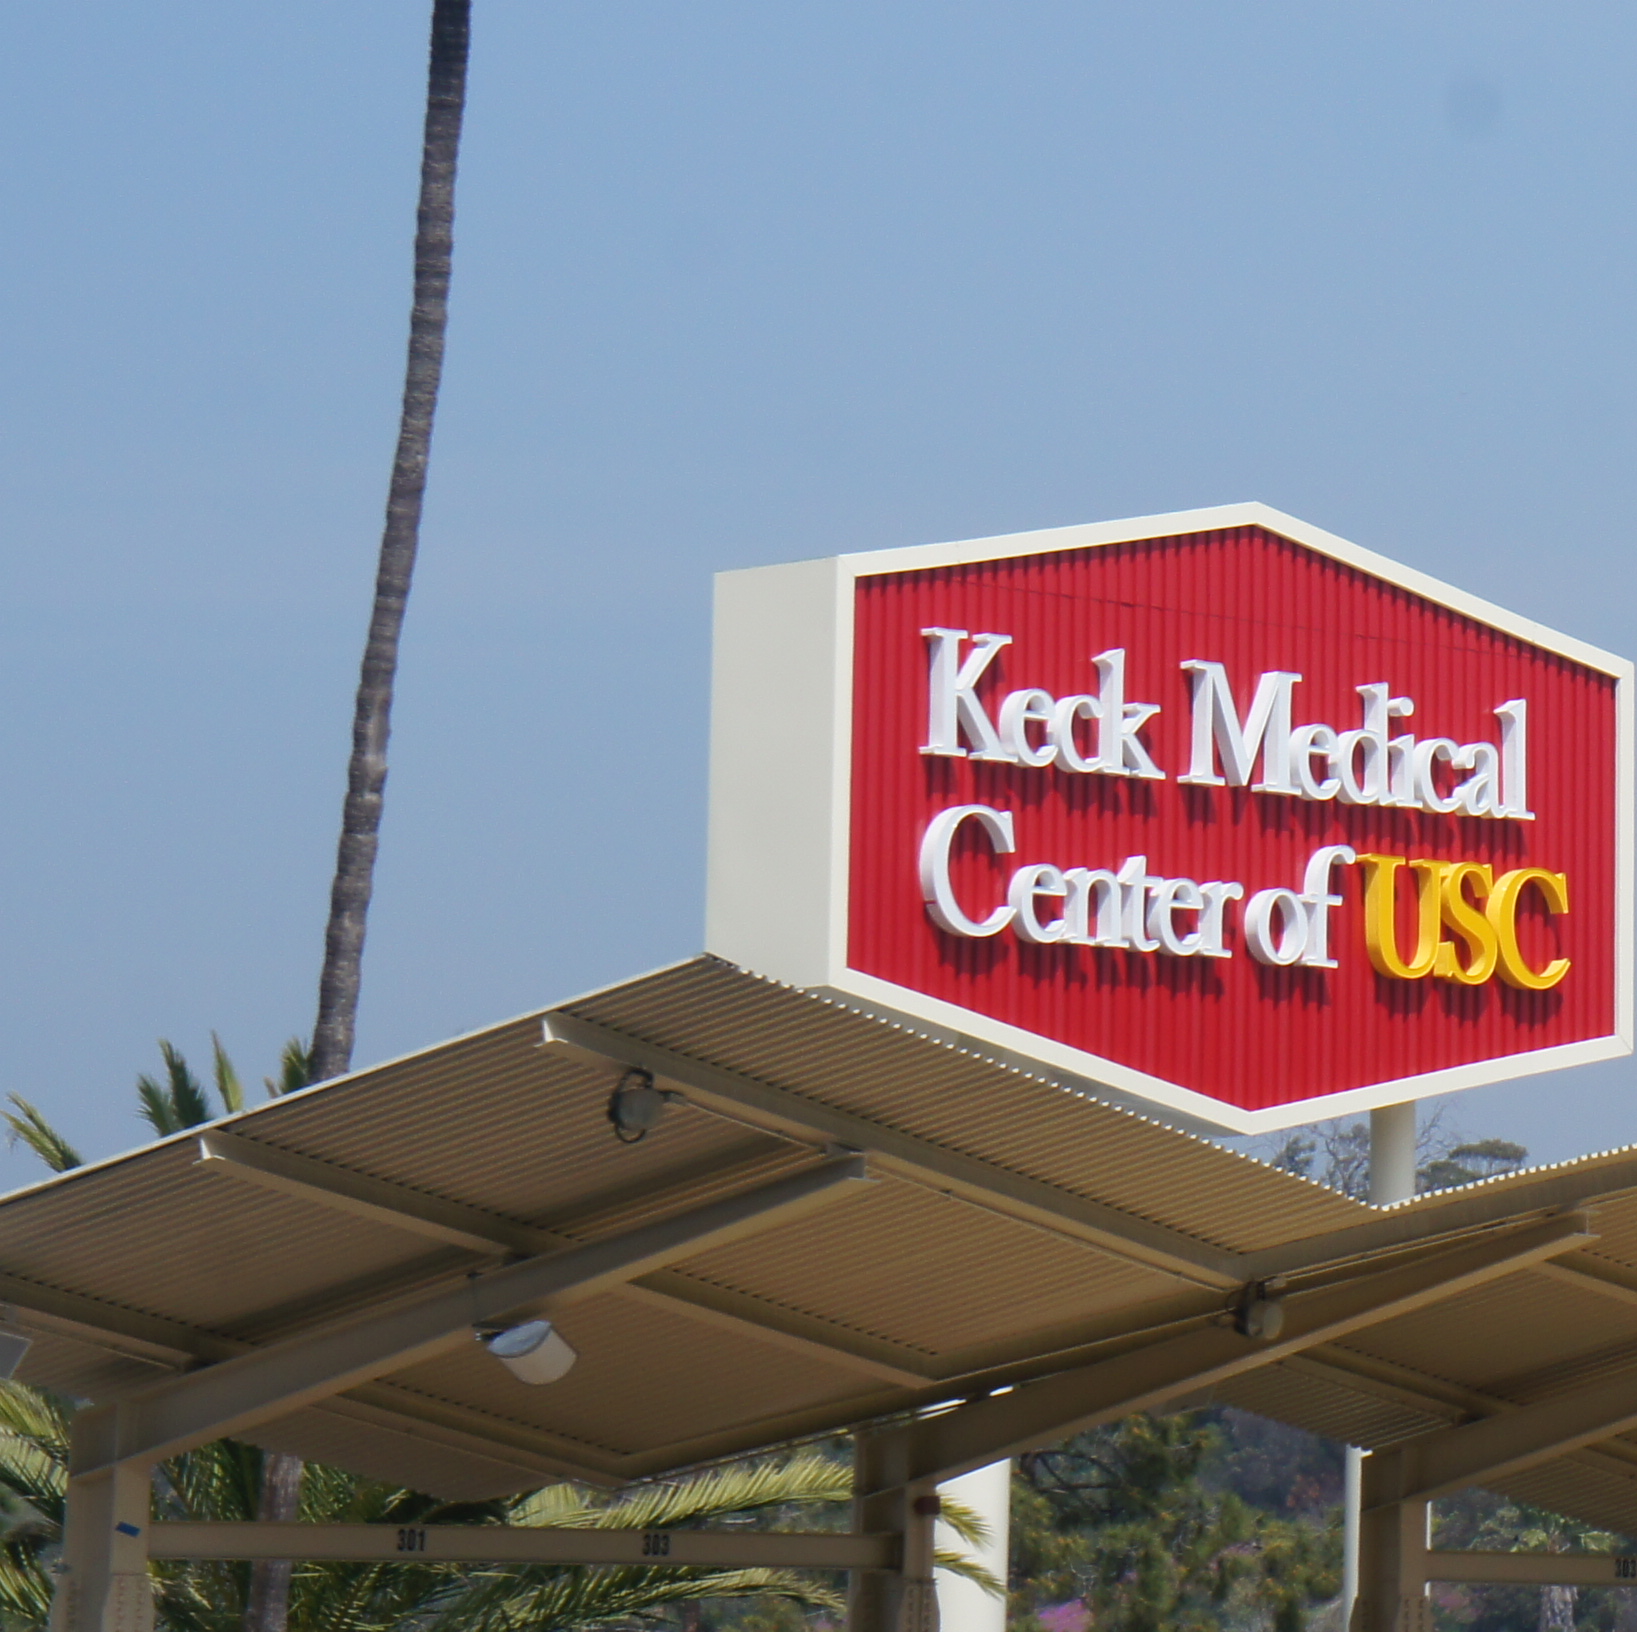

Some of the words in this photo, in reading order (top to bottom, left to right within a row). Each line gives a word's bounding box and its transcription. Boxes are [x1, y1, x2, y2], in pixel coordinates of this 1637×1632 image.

[919, 627, 1166, 780] Keck
[1178, 659, 1536, 821] Medical
[919, 803, 1243, 959] Center
[1244, 845, 1356, 968] of
[1356, 852, 1571, 990] USC
[396, 1528, 426, 1552] 301
[642, 1533, 671, 1557] 303
[1614, 1558, 1637, 1579] 303
